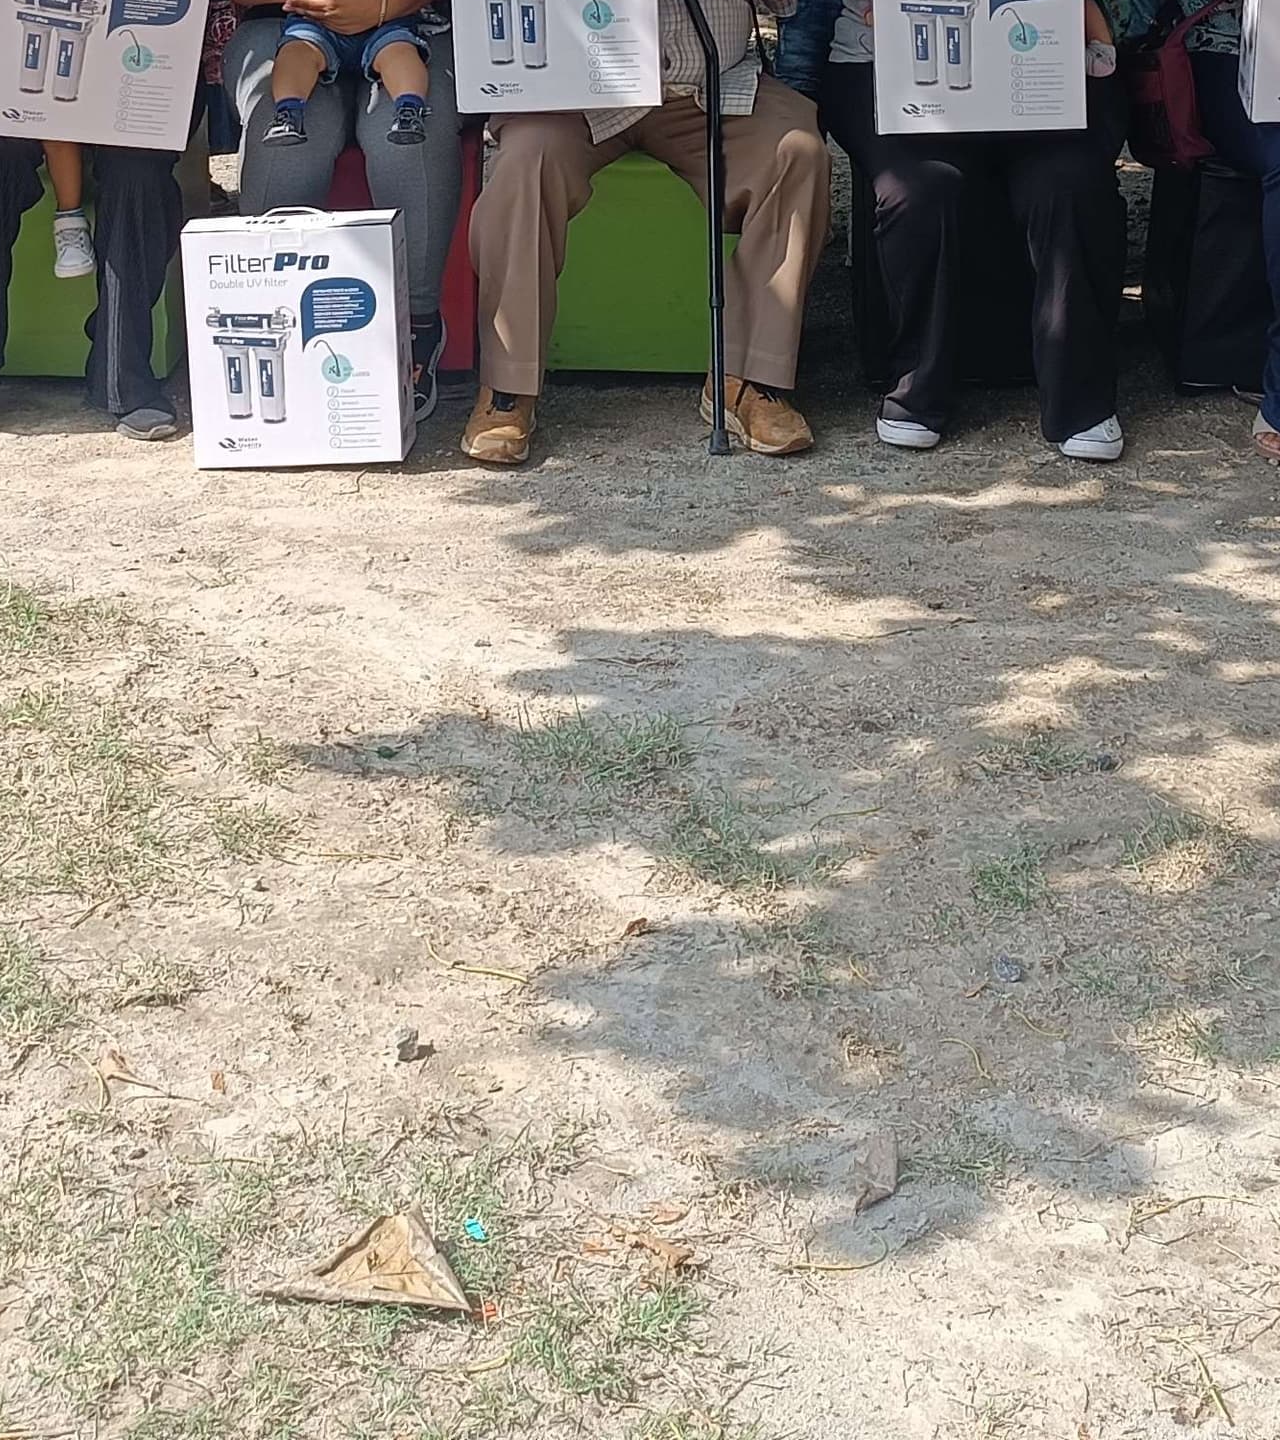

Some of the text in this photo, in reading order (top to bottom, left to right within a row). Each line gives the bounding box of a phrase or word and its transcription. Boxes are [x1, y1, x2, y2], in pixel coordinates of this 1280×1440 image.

[208, 252, 330, 274] FilterPro
[209, 278, 288, 290] Double UV filter
